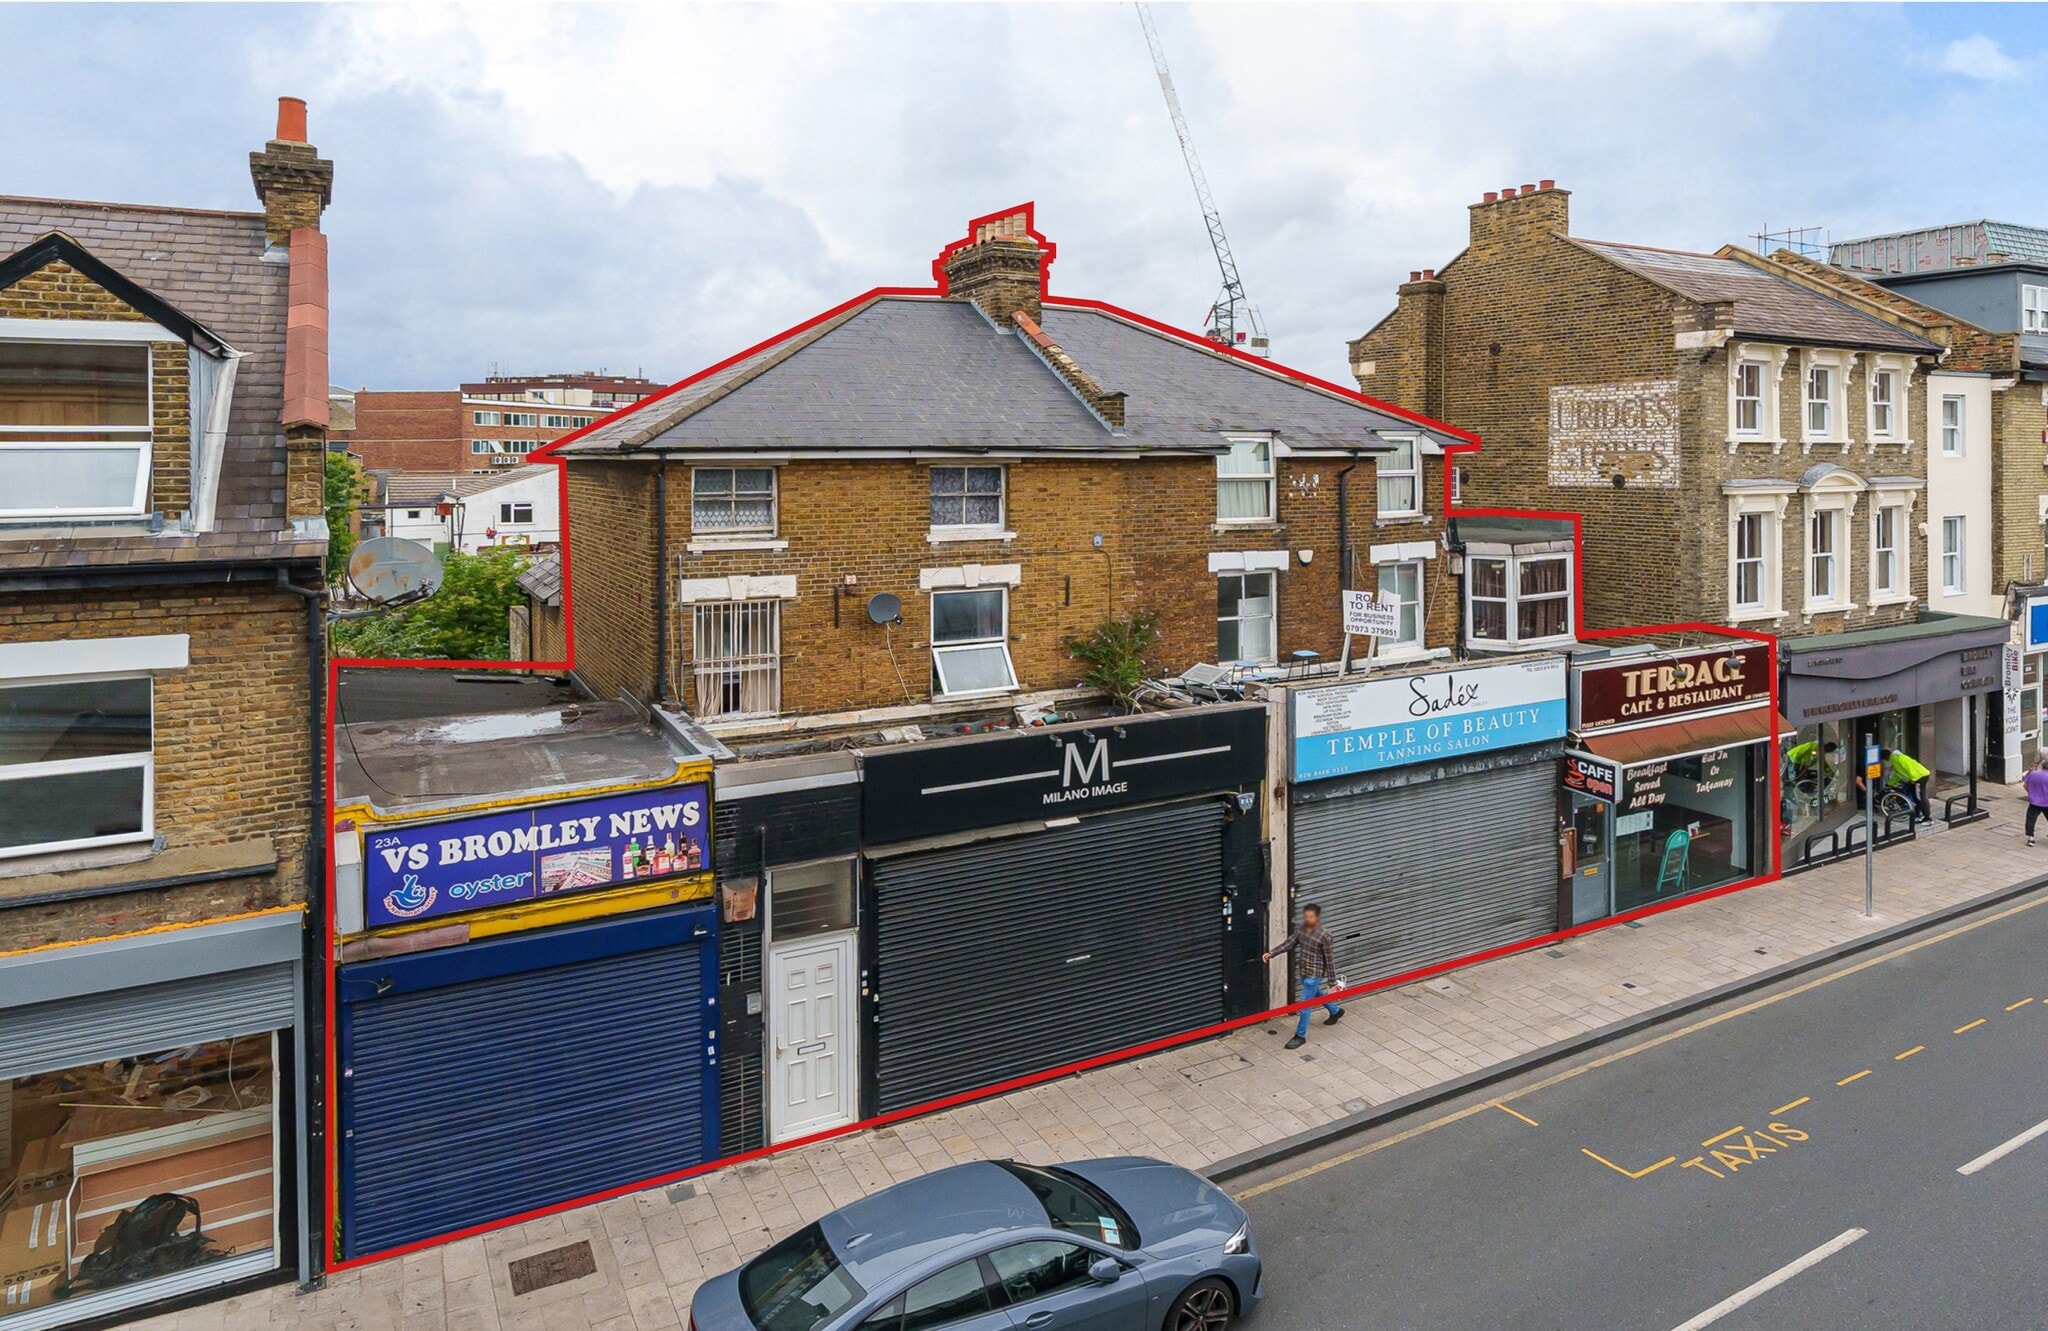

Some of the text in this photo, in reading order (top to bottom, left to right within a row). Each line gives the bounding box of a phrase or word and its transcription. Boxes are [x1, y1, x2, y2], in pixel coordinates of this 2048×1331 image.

[1349, 601, 1394, 613] TO RENT
[1350, 617, 1394, 626] OPPORTUNITY
[1363, 613, 1394, 621] BUSINESS
[1346, 624, 1397, 636] 07973 379951
[2004, 646, 2013, 686] Bromley
[1622, 655, 1747, 698] TERRACE
[1656, 698, 1666, 710] &
[1668, 684, 1744, 707] RESTAURANT
[2005, 716, 2019, 727] YOGA
[2005, 725, 2018, 735] JOINT
[1326, 708, 1540, 756] TEMPLE OF BEAUTY
[1377, 735, 1490, 762] TANNING SALON
[1701, 751, 1716, 764] Eat
[1062, 738, 1110, 787] M
[1578, 761, 1613, 783] CAFE
[1626, 762, 1668, 782] Breakfast
[1710, 765, 1720, 776] Or
[1042, 781, 1128, 805] MILANO IMAGE
[1586, 777, 1613, 796] open
[1634, 777, 1662, 794] Served
[1695, 777, 1734, 794] Takeaway
[1629, 793, 1666, 810] All Day
[374, 835, 401, 849] 23A
[381, 801, 701, 874] VS BROMLEY NEWS
[448, 872, 532, 901] oyster
[1680, 1121, 1810, 1179] TAXIS
